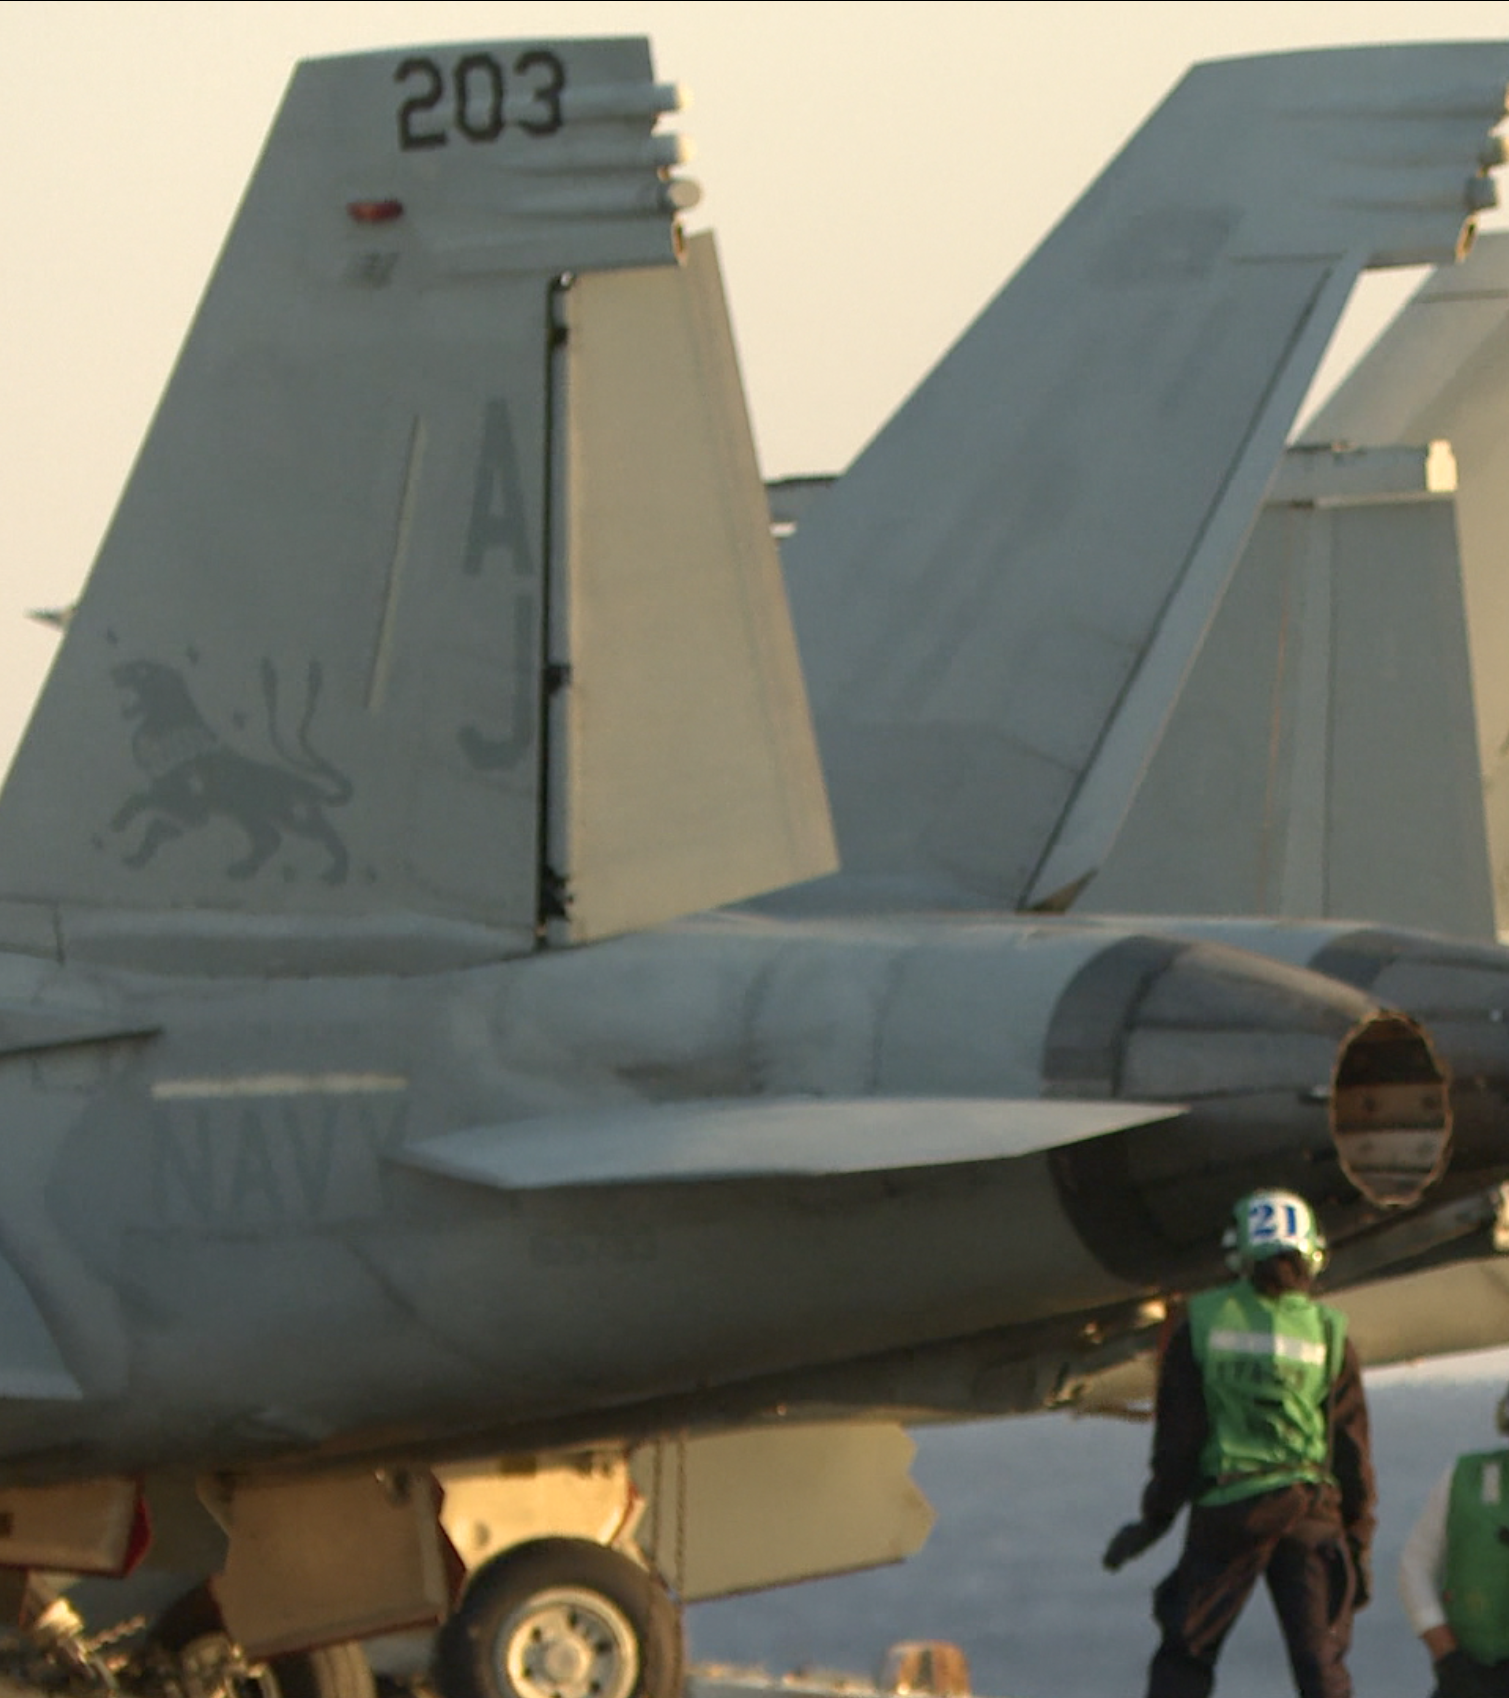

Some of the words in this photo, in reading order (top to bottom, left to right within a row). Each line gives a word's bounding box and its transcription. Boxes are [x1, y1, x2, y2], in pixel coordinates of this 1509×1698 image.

[395, 50, 566, 149] 203
[147, 1097, 411, 1218] NAVY
[1247, 1204, 1299, 1238] 21
